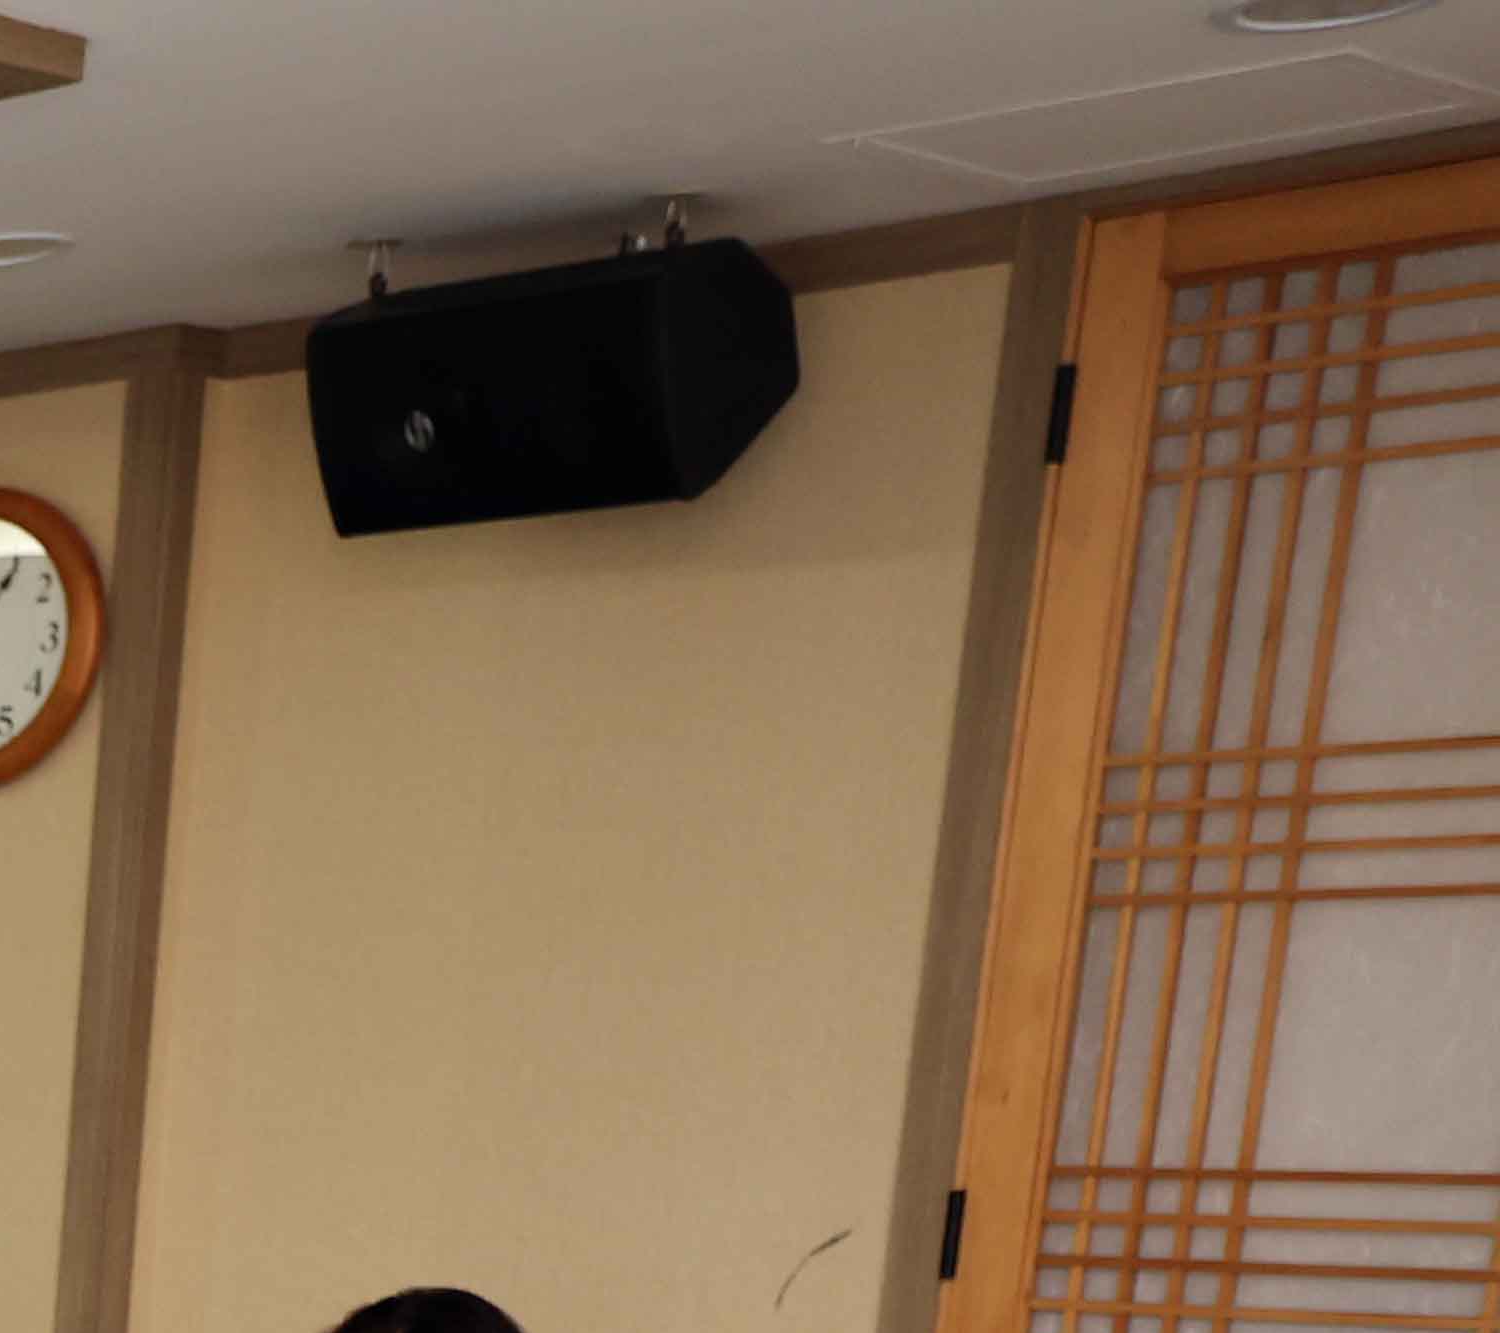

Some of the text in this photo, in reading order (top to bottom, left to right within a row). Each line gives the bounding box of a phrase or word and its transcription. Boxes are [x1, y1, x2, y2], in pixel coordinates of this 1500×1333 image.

[35, 573, 53, 605] 2
[40, 622, 60, 654] 3
[24, 669, 42, 697] 4
